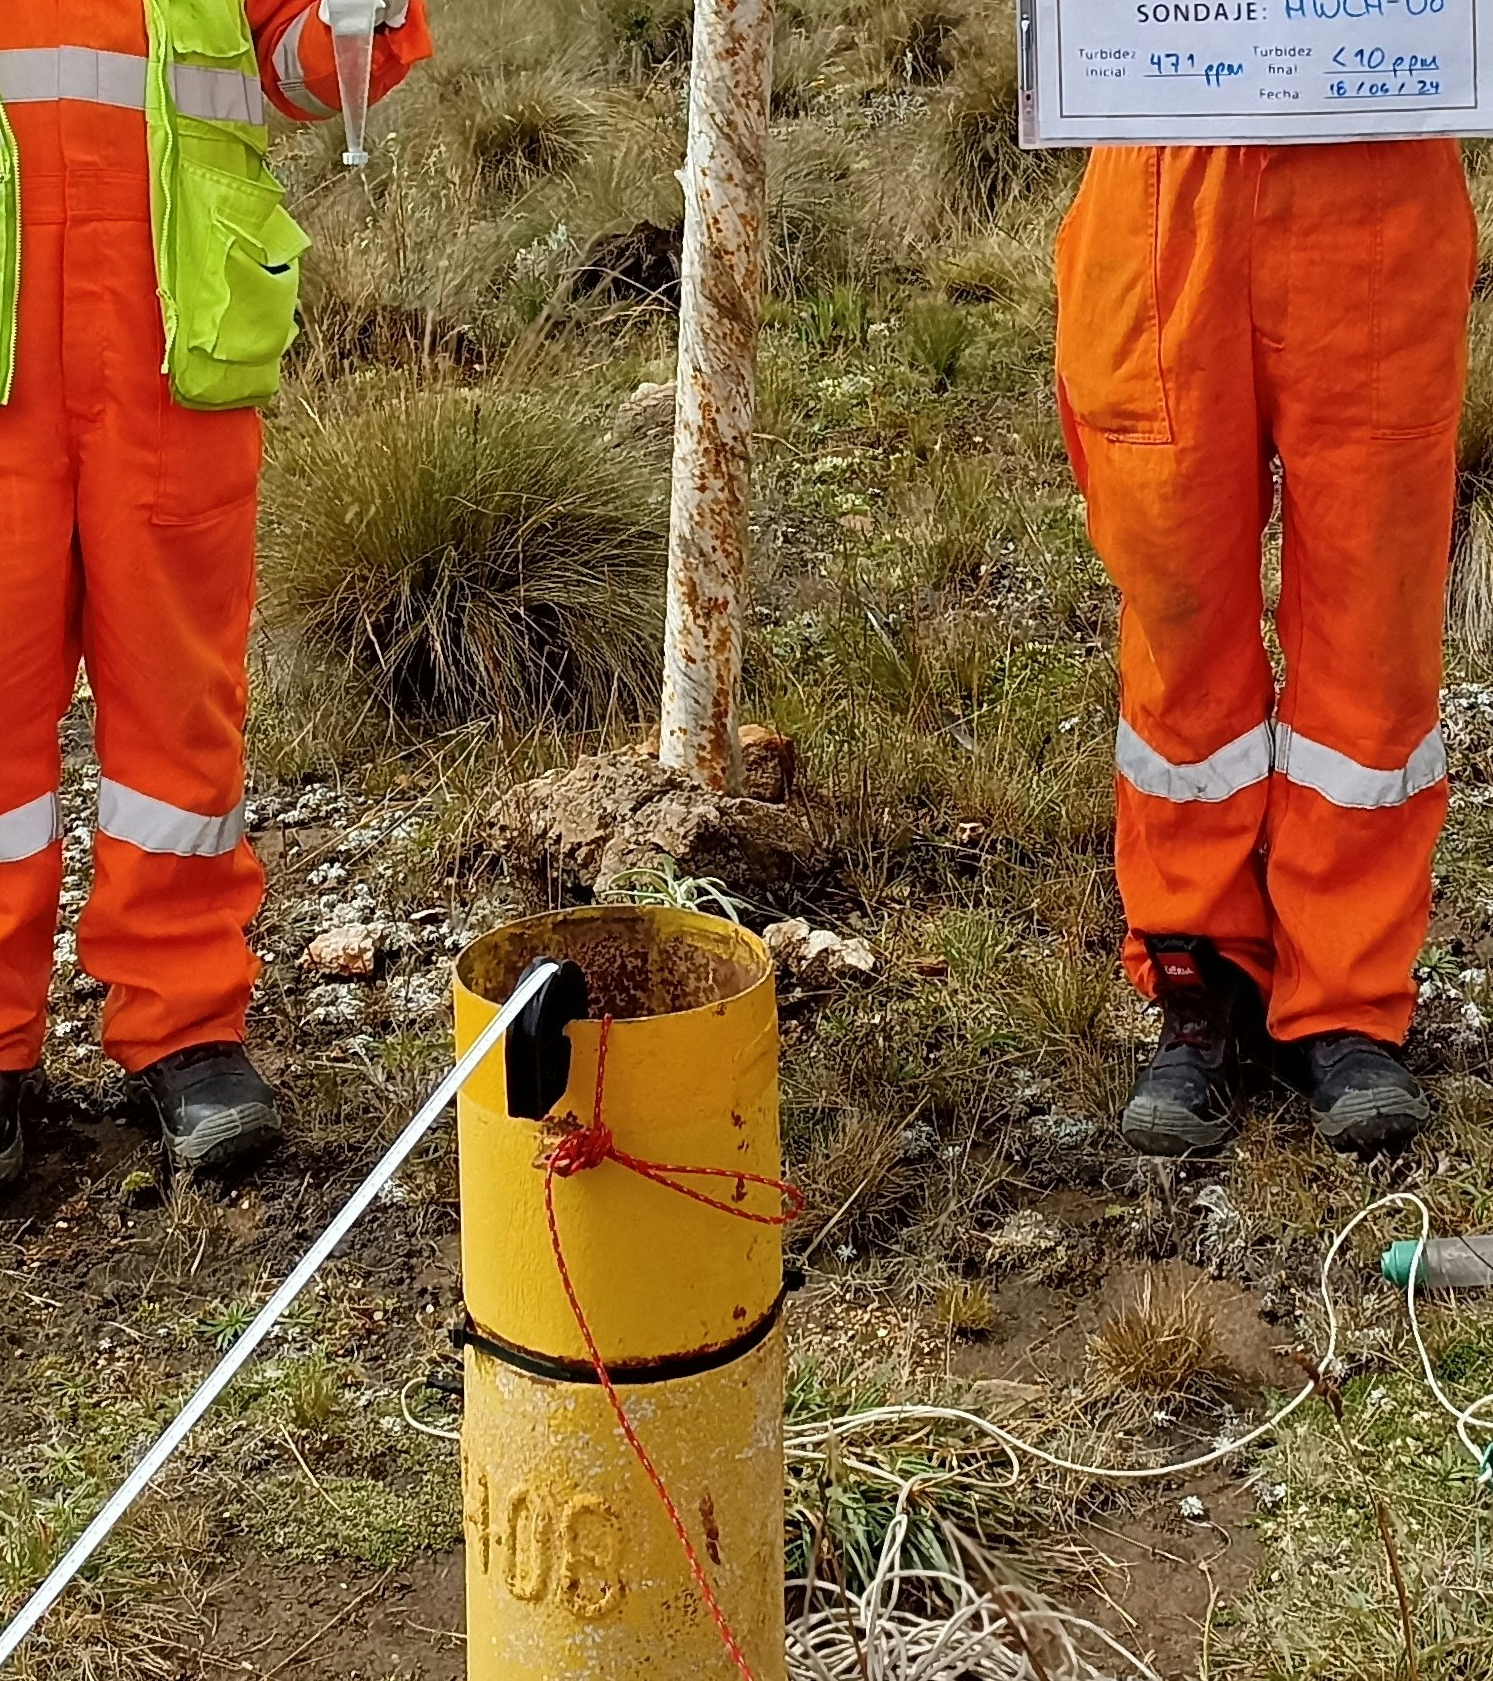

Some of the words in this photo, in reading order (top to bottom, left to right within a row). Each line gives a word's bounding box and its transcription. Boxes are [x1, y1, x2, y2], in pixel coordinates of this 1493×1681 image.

[1136, 2, 1268, 24] SONDAJE:
[1077, 48, 1138, 61] Turbidez
[1253, 45, 1313, 59] Turbidez
